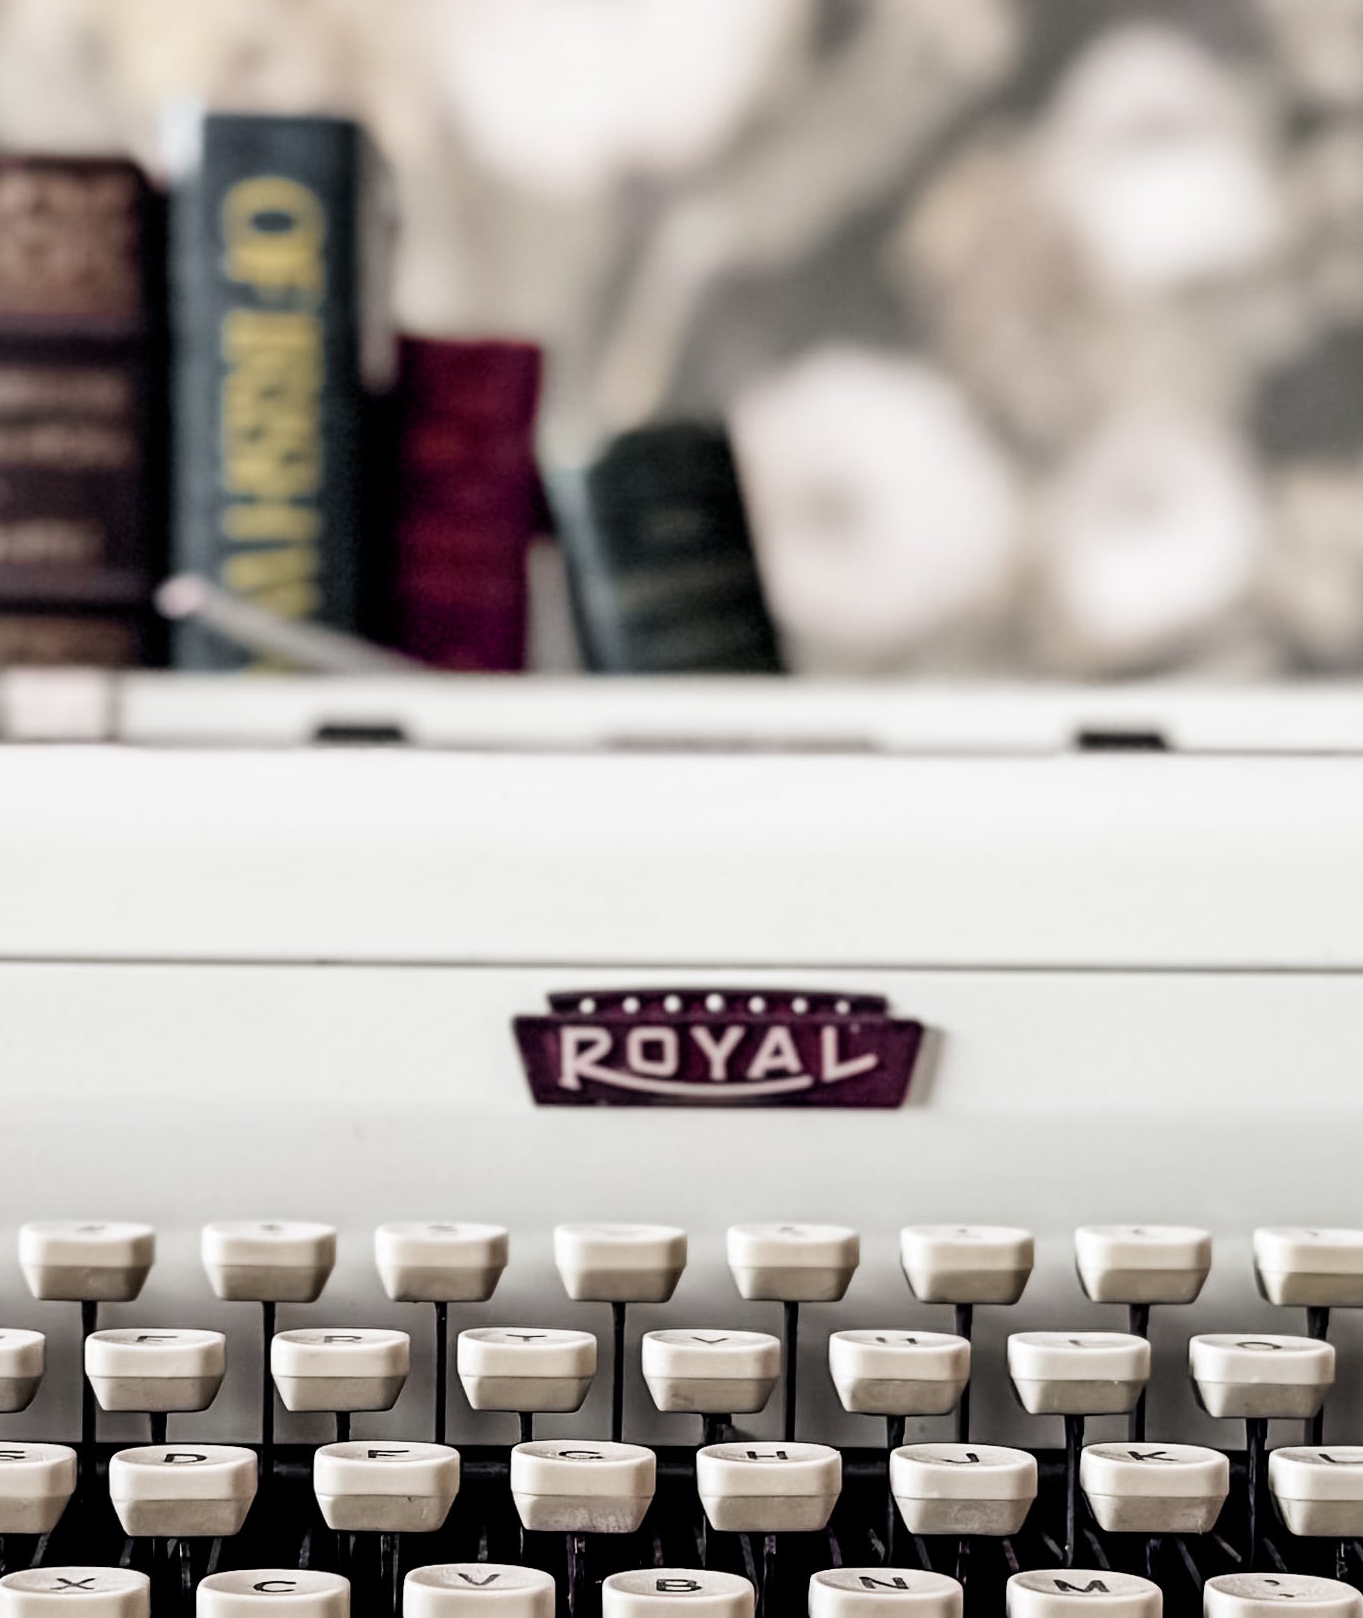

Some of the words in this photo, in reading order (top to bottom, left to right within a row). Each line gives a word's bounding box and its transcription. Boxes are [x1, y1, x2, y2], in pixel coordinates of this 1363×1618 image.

[558, 1025, 879, 1096] ROYAL
[162, 1454, 207, 1464] D
[747, 1450, 789, 1461] H
[944, 1452, 981, 1465] J
[1128, 1451, 1179, 1463] K
[51, 1578, 95, 1590] X
[458, 1573, 500, 1585] V
[859, 1577, 909, 1589] N
[253, 1581, 296, 1592] C
[656, 1579, 702, 1592] B
[1053, 1579, 1111, 1594] M
